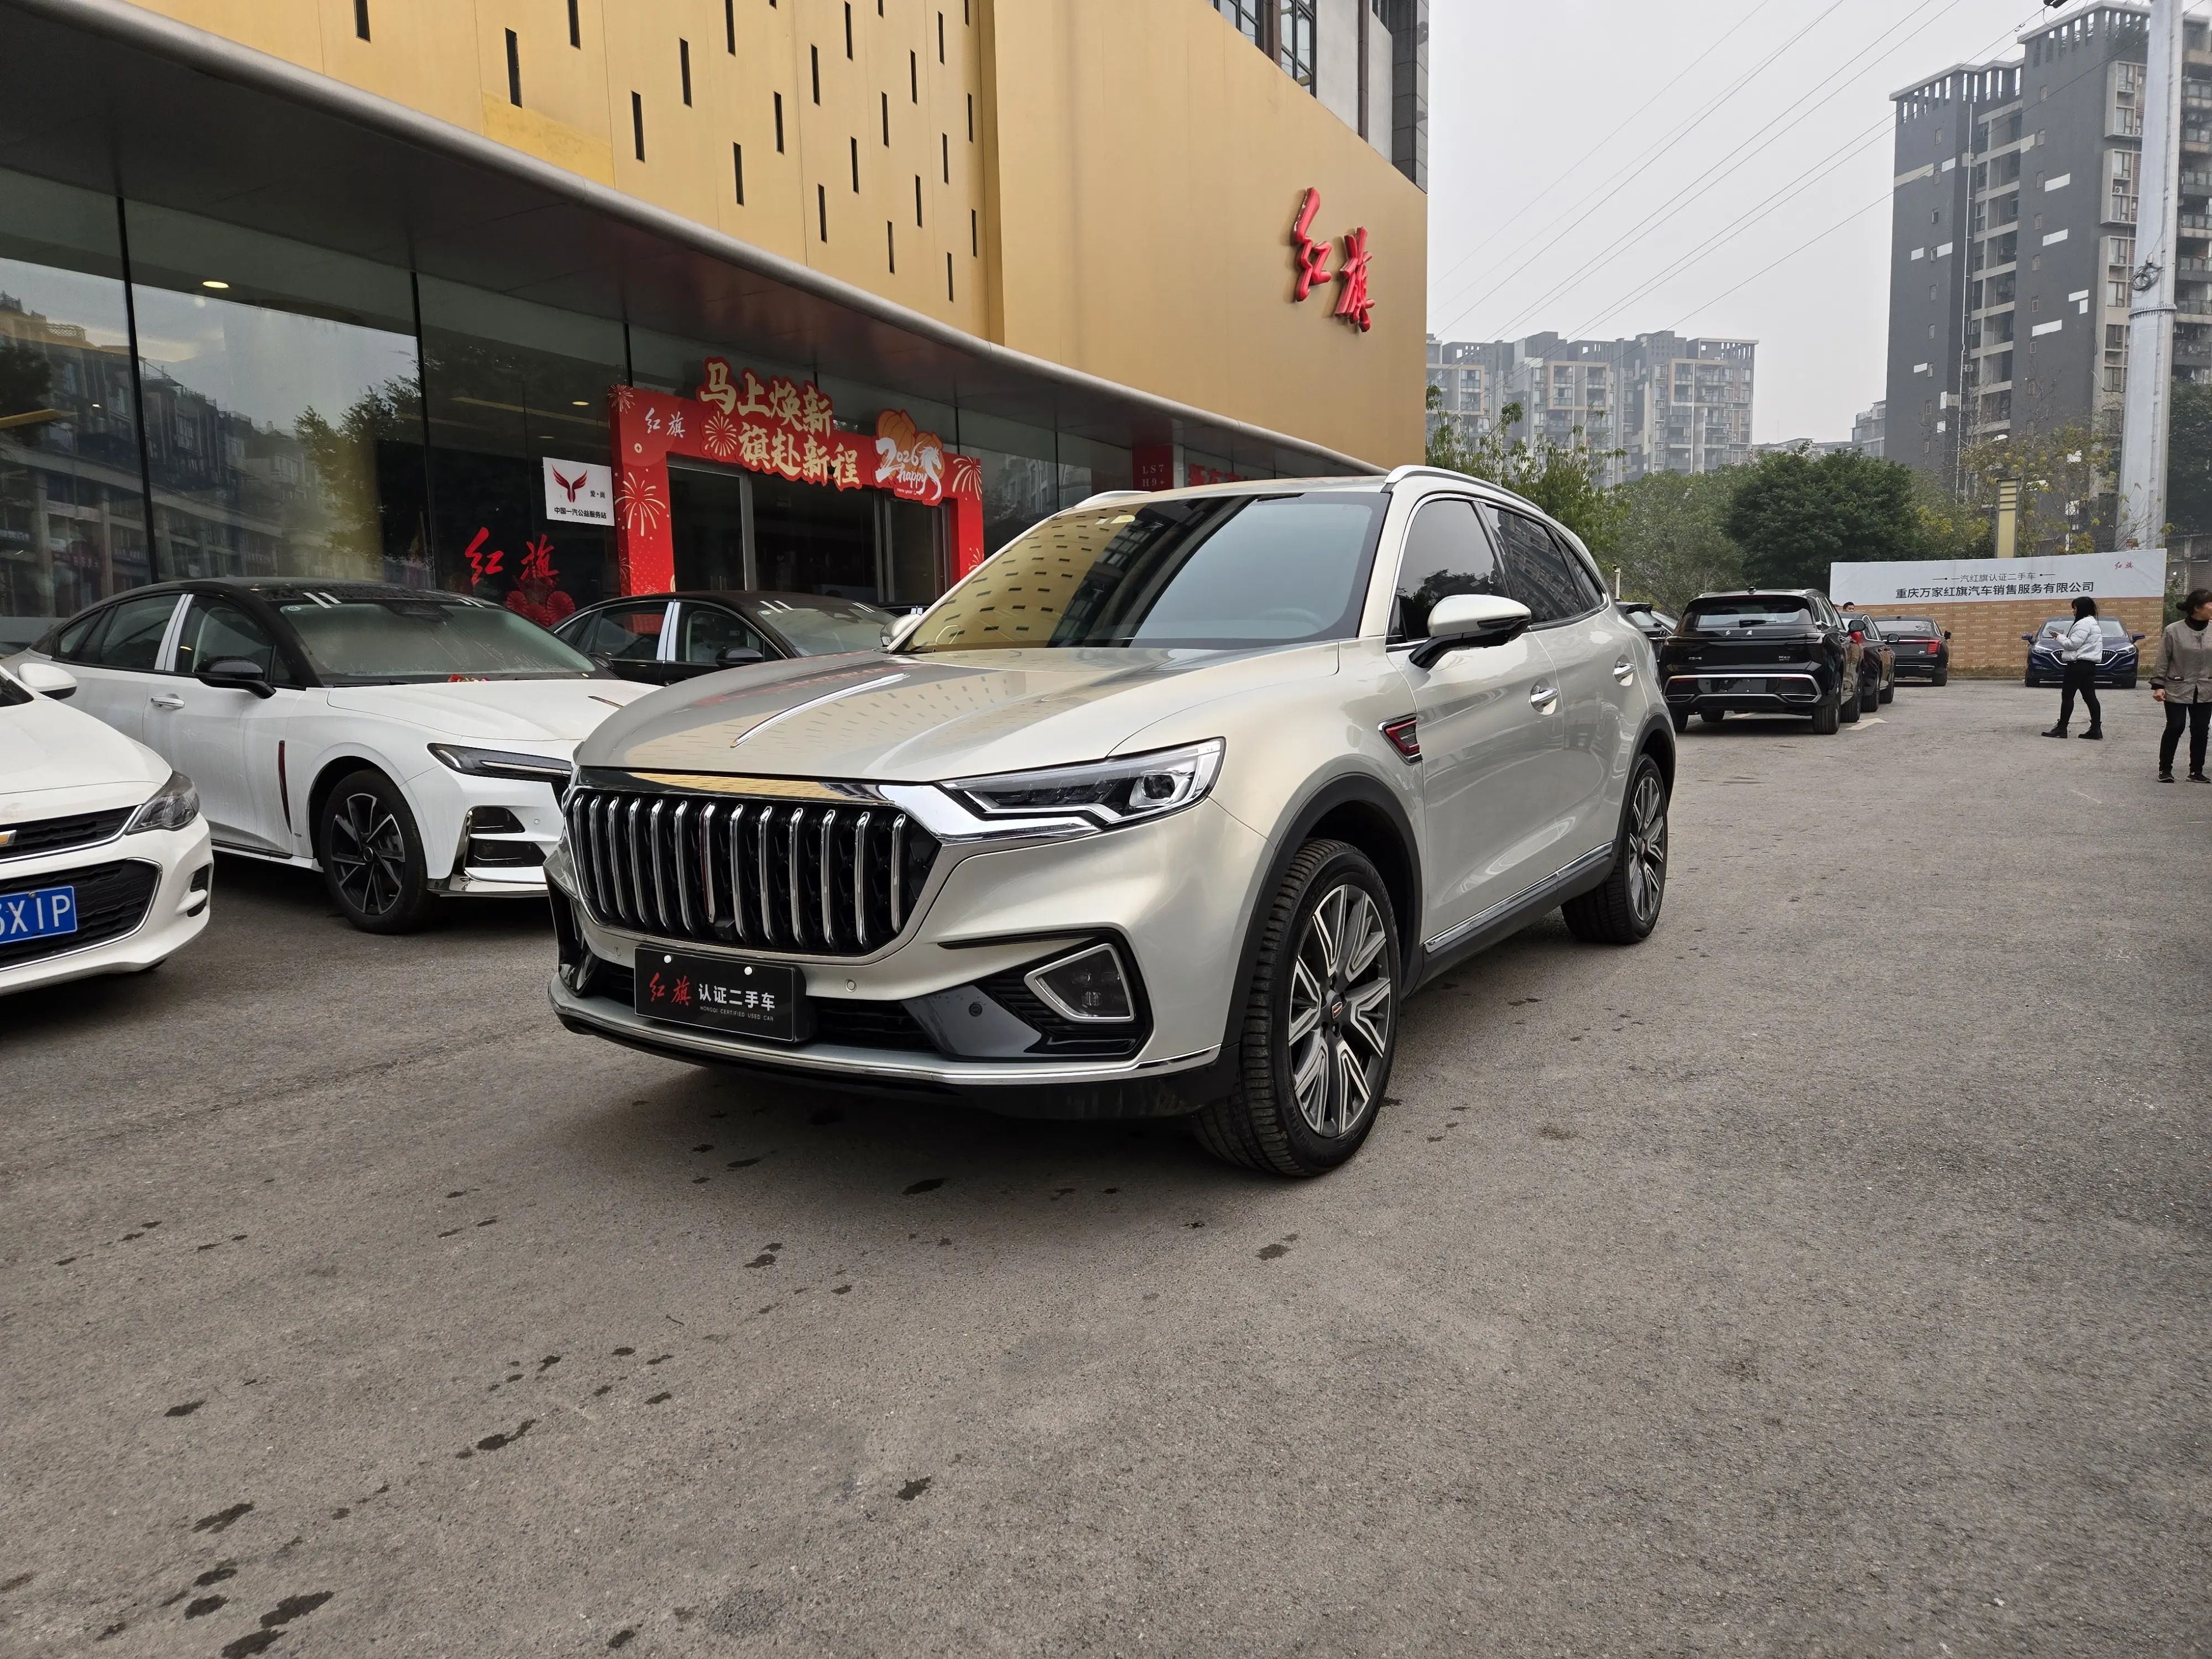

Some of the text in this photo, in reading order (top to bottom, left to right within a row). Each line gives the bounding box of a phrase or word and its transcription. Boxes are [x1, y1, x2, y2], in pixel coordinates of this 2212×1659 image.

[1290, 187, 1375, 332] 红旗
[700, 362, 833, 439] 马上焕新
[645, 407, 686, 439] 红旗
[738, 421, 860, 487] 旗赴新程
[875, 437, 925, 483] 2026
[1142, 465, 1164, 474] LS7
[896, 463, 927, 495] happy
[554, 507, 607, 519] 中国一汽公益服务站
[465, 527, 559, 585] 红旗
[2115, 561, 2133, 570] 红旗
[1896, 582, 2094, 599] 重庆万家红旗汽车销售服务有限公司
[1951, 571, 2036, 583] 一汽红旗认证二手车
[649, 972, 775, 1011] 红旗 认证二手车
[720, 1009, 745, 1017] CERTIFIED
